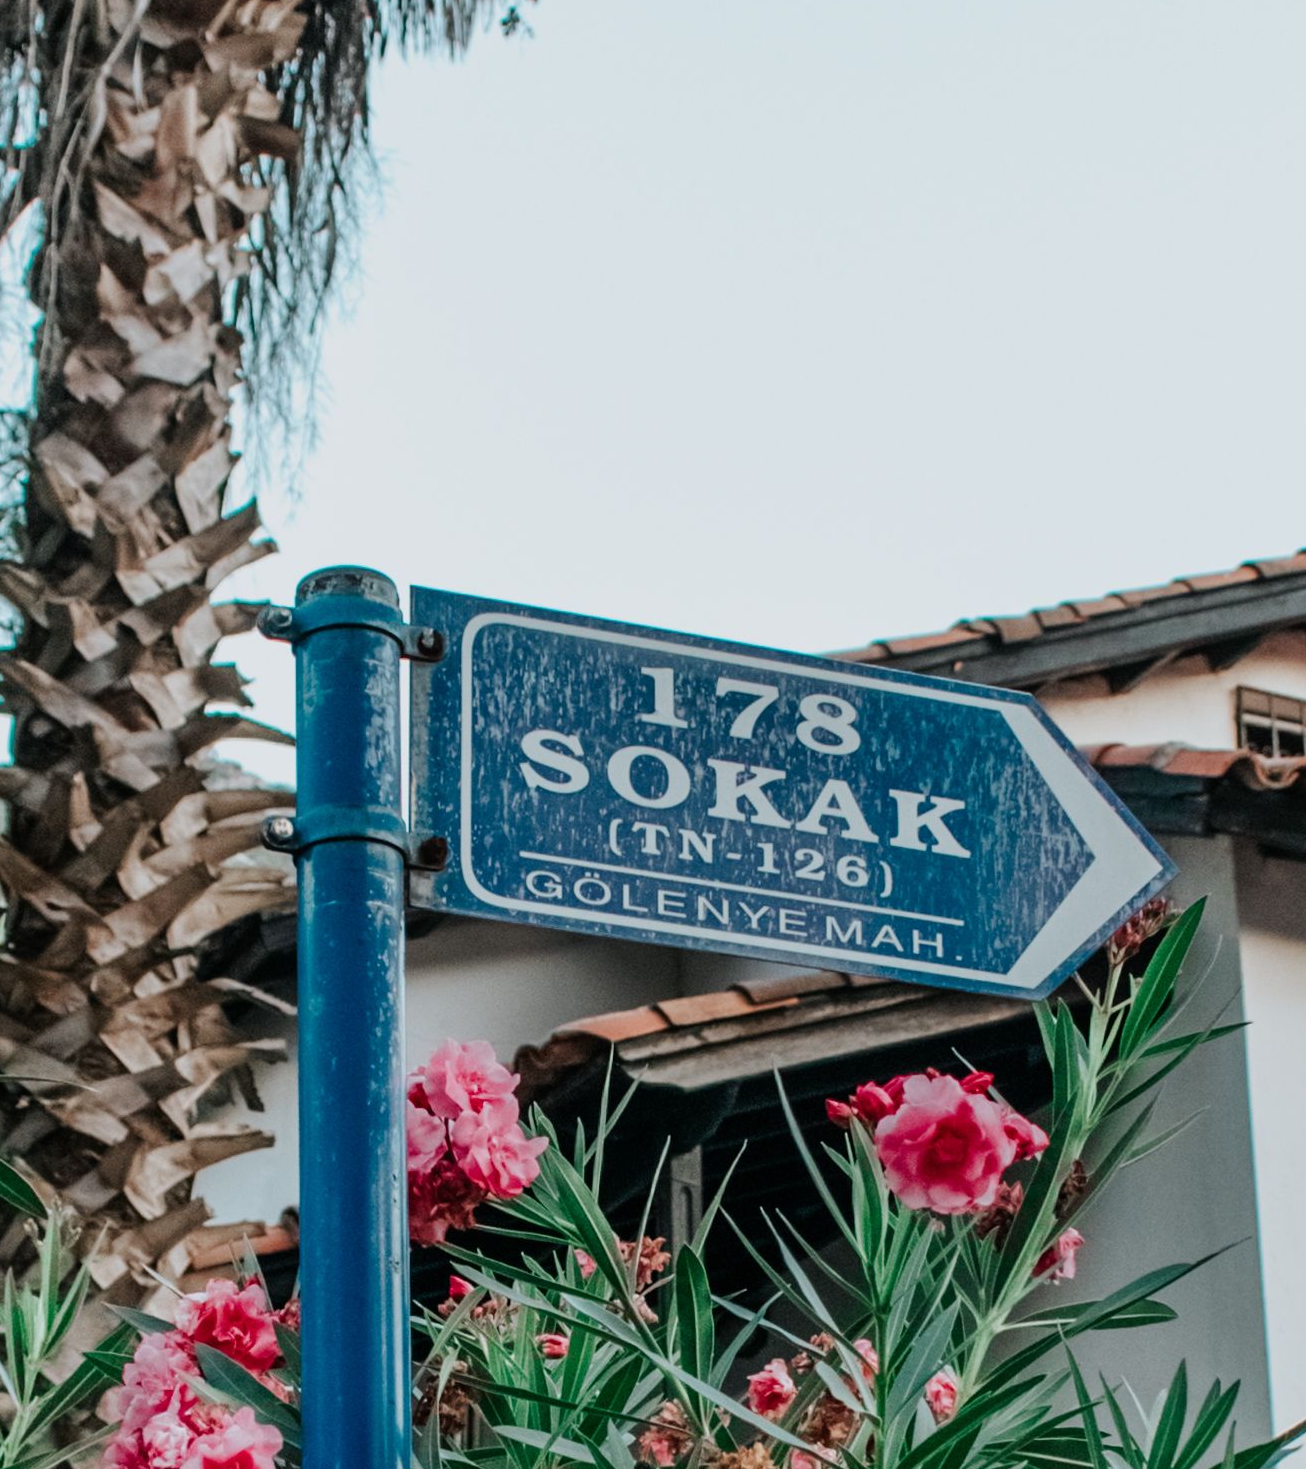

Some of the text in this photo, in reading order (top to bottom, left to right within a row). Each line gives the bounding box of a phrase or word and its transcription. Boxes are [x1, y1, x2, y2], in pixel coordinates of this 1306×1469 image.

[641, 667, 862, 755] 178
[520, 729, 971, 858] SOKAK
[610, 818, 893, 898] (TN-126)
[526, 869, 963, 961] GÖLENYE MAH.
